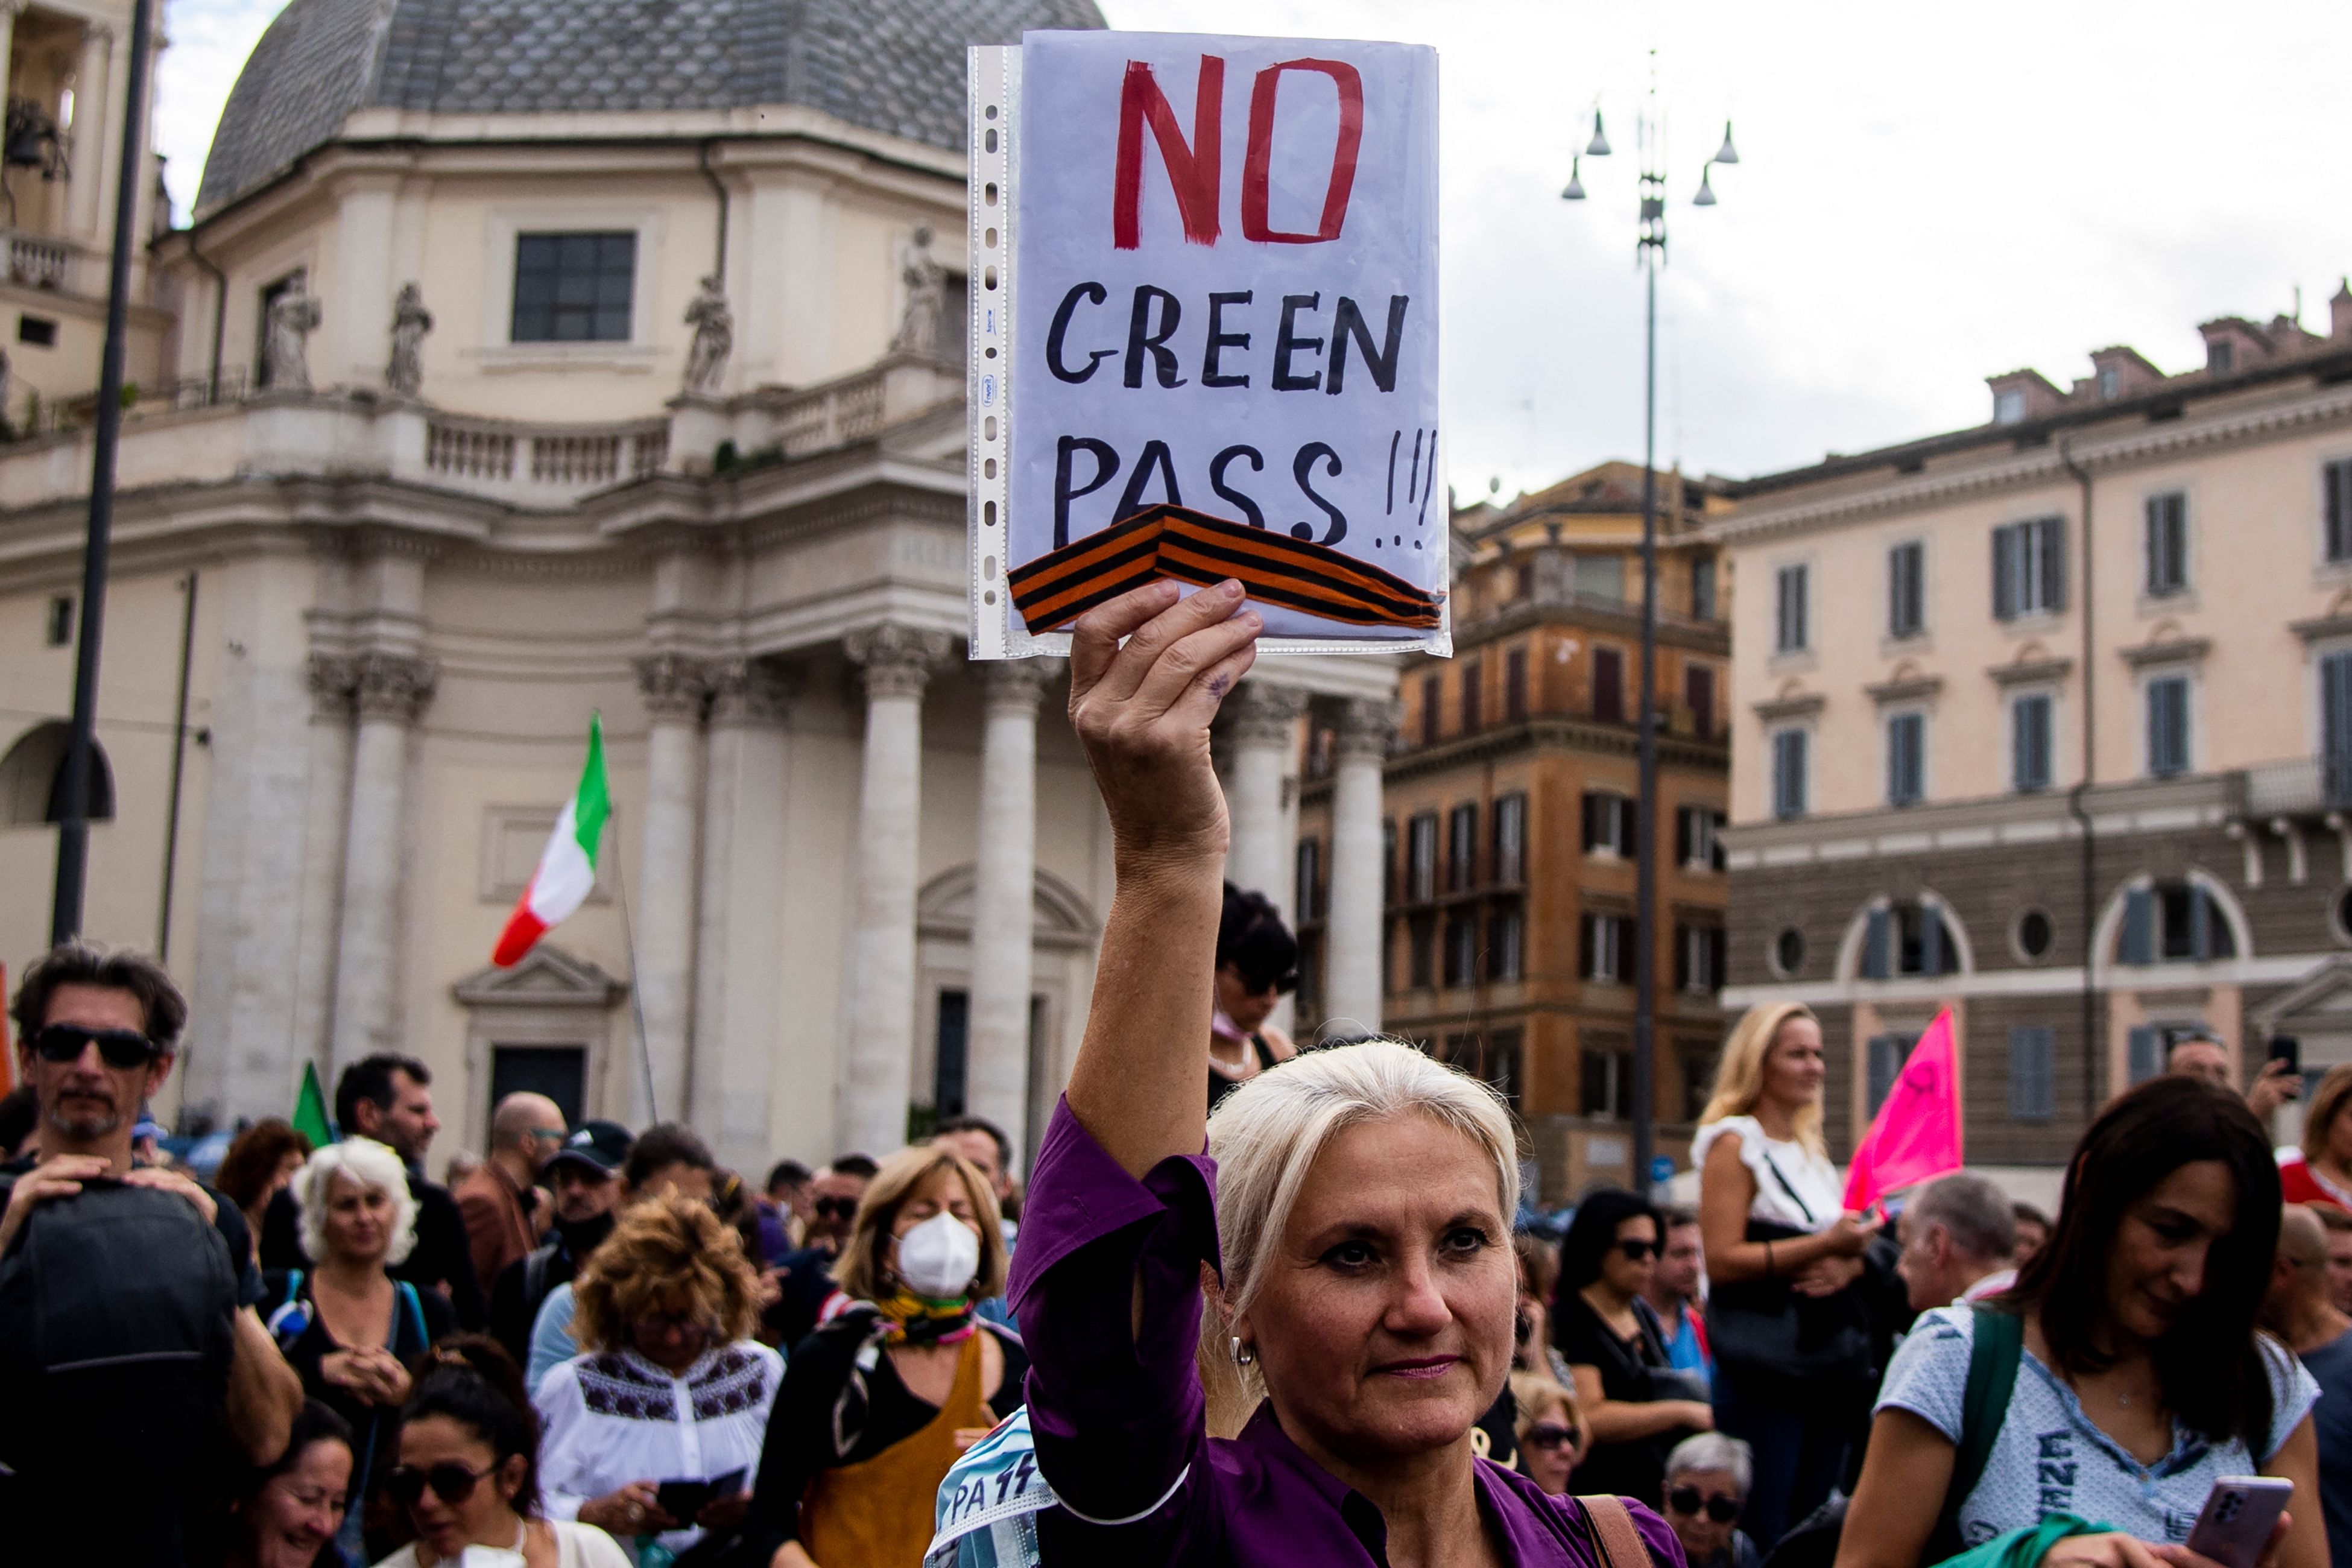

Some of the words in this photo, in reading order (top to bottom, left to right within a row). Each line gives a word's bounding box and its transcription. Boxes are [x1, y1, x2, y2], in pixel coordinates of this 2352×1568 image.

[1114, 54, 1363, 250] NO
[984, 378, 993, 405] Favorit
[1046, 281, 1410, 396] GREEN
